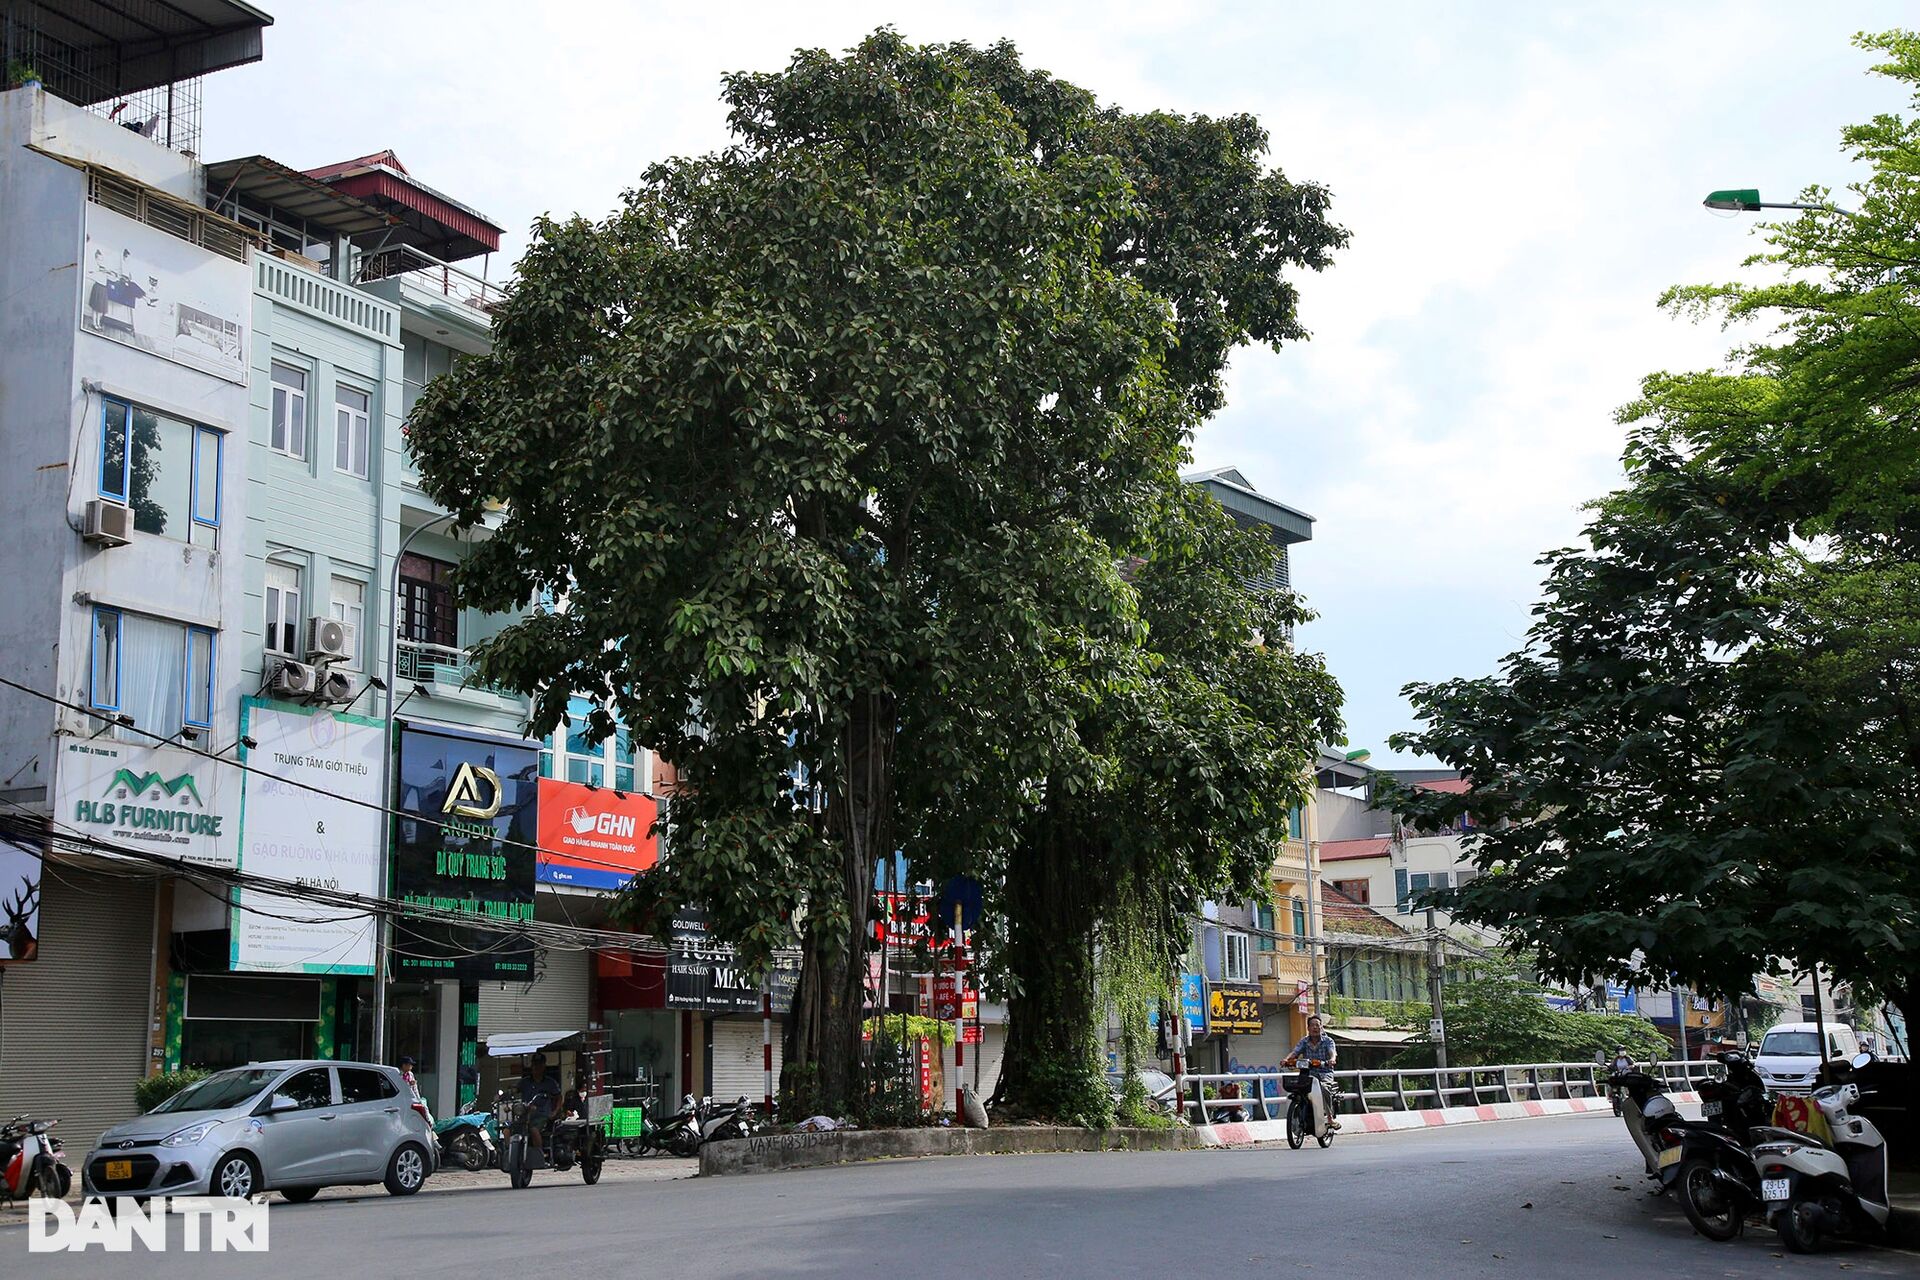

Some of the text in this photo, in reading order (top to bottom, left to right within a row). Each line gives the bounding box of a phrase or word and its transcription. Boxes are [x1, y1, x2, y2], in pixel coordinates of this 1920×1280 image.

[274, 752, 368, 777] TRUNG TÂM GIỚI THIỆU
[76, 799, 224, 837] HLB FURNITURE
[597, 812, 636, 838] GHN
[316, 820, 325, 834] &
[252, 843, 278, 860] GẠO
[563, 836, 636, 853] GIAO HÀNG NHANH TOÀN QUỐC
[466, 853, 489, 879] TRANG
[672, 919, 706, 931] GOLDWELL
[672, 965, 709, 976] HAIR SALON
[1765, 1179, 1786, 1190] 29-L5
